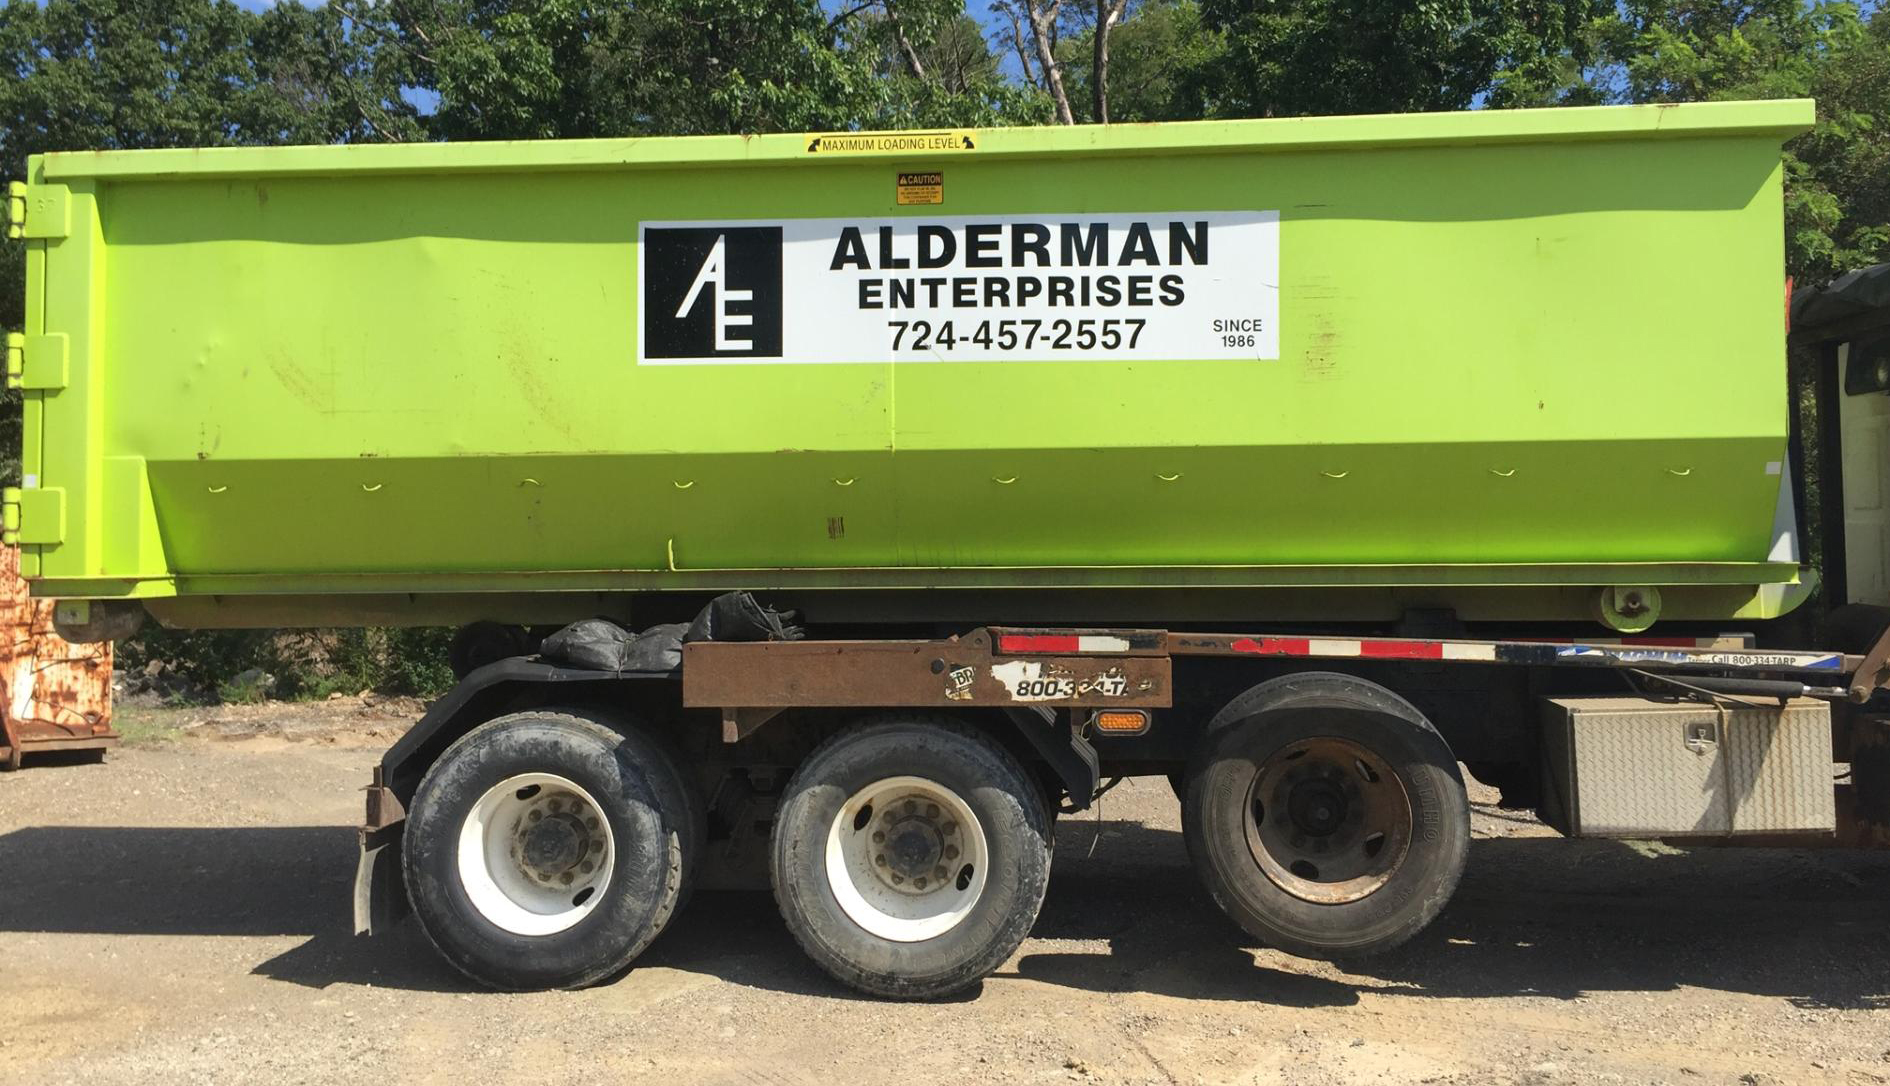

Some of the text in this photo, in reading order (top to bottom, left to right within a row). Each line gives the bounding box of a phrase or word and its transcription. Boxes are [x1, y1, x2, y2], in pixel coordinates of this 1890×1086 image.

[822, 137, 960, 151] MAXIMUM LOADING LEVEL
[908, 174, 941, 184] CAUTION
[829, 221, 1209, 270] ALDERMAN
[858, 274, 1185, 309] ENTERPRISES
[1213, 319, 1262, 332] SINCE
[887, 318, 1146, 350] 724-457-2557
[1221, 335, 1255, 347] 1986
[1711, 655, 1729, 664] Call
[1732, 656, 1796, 665] 800-334-TARP
